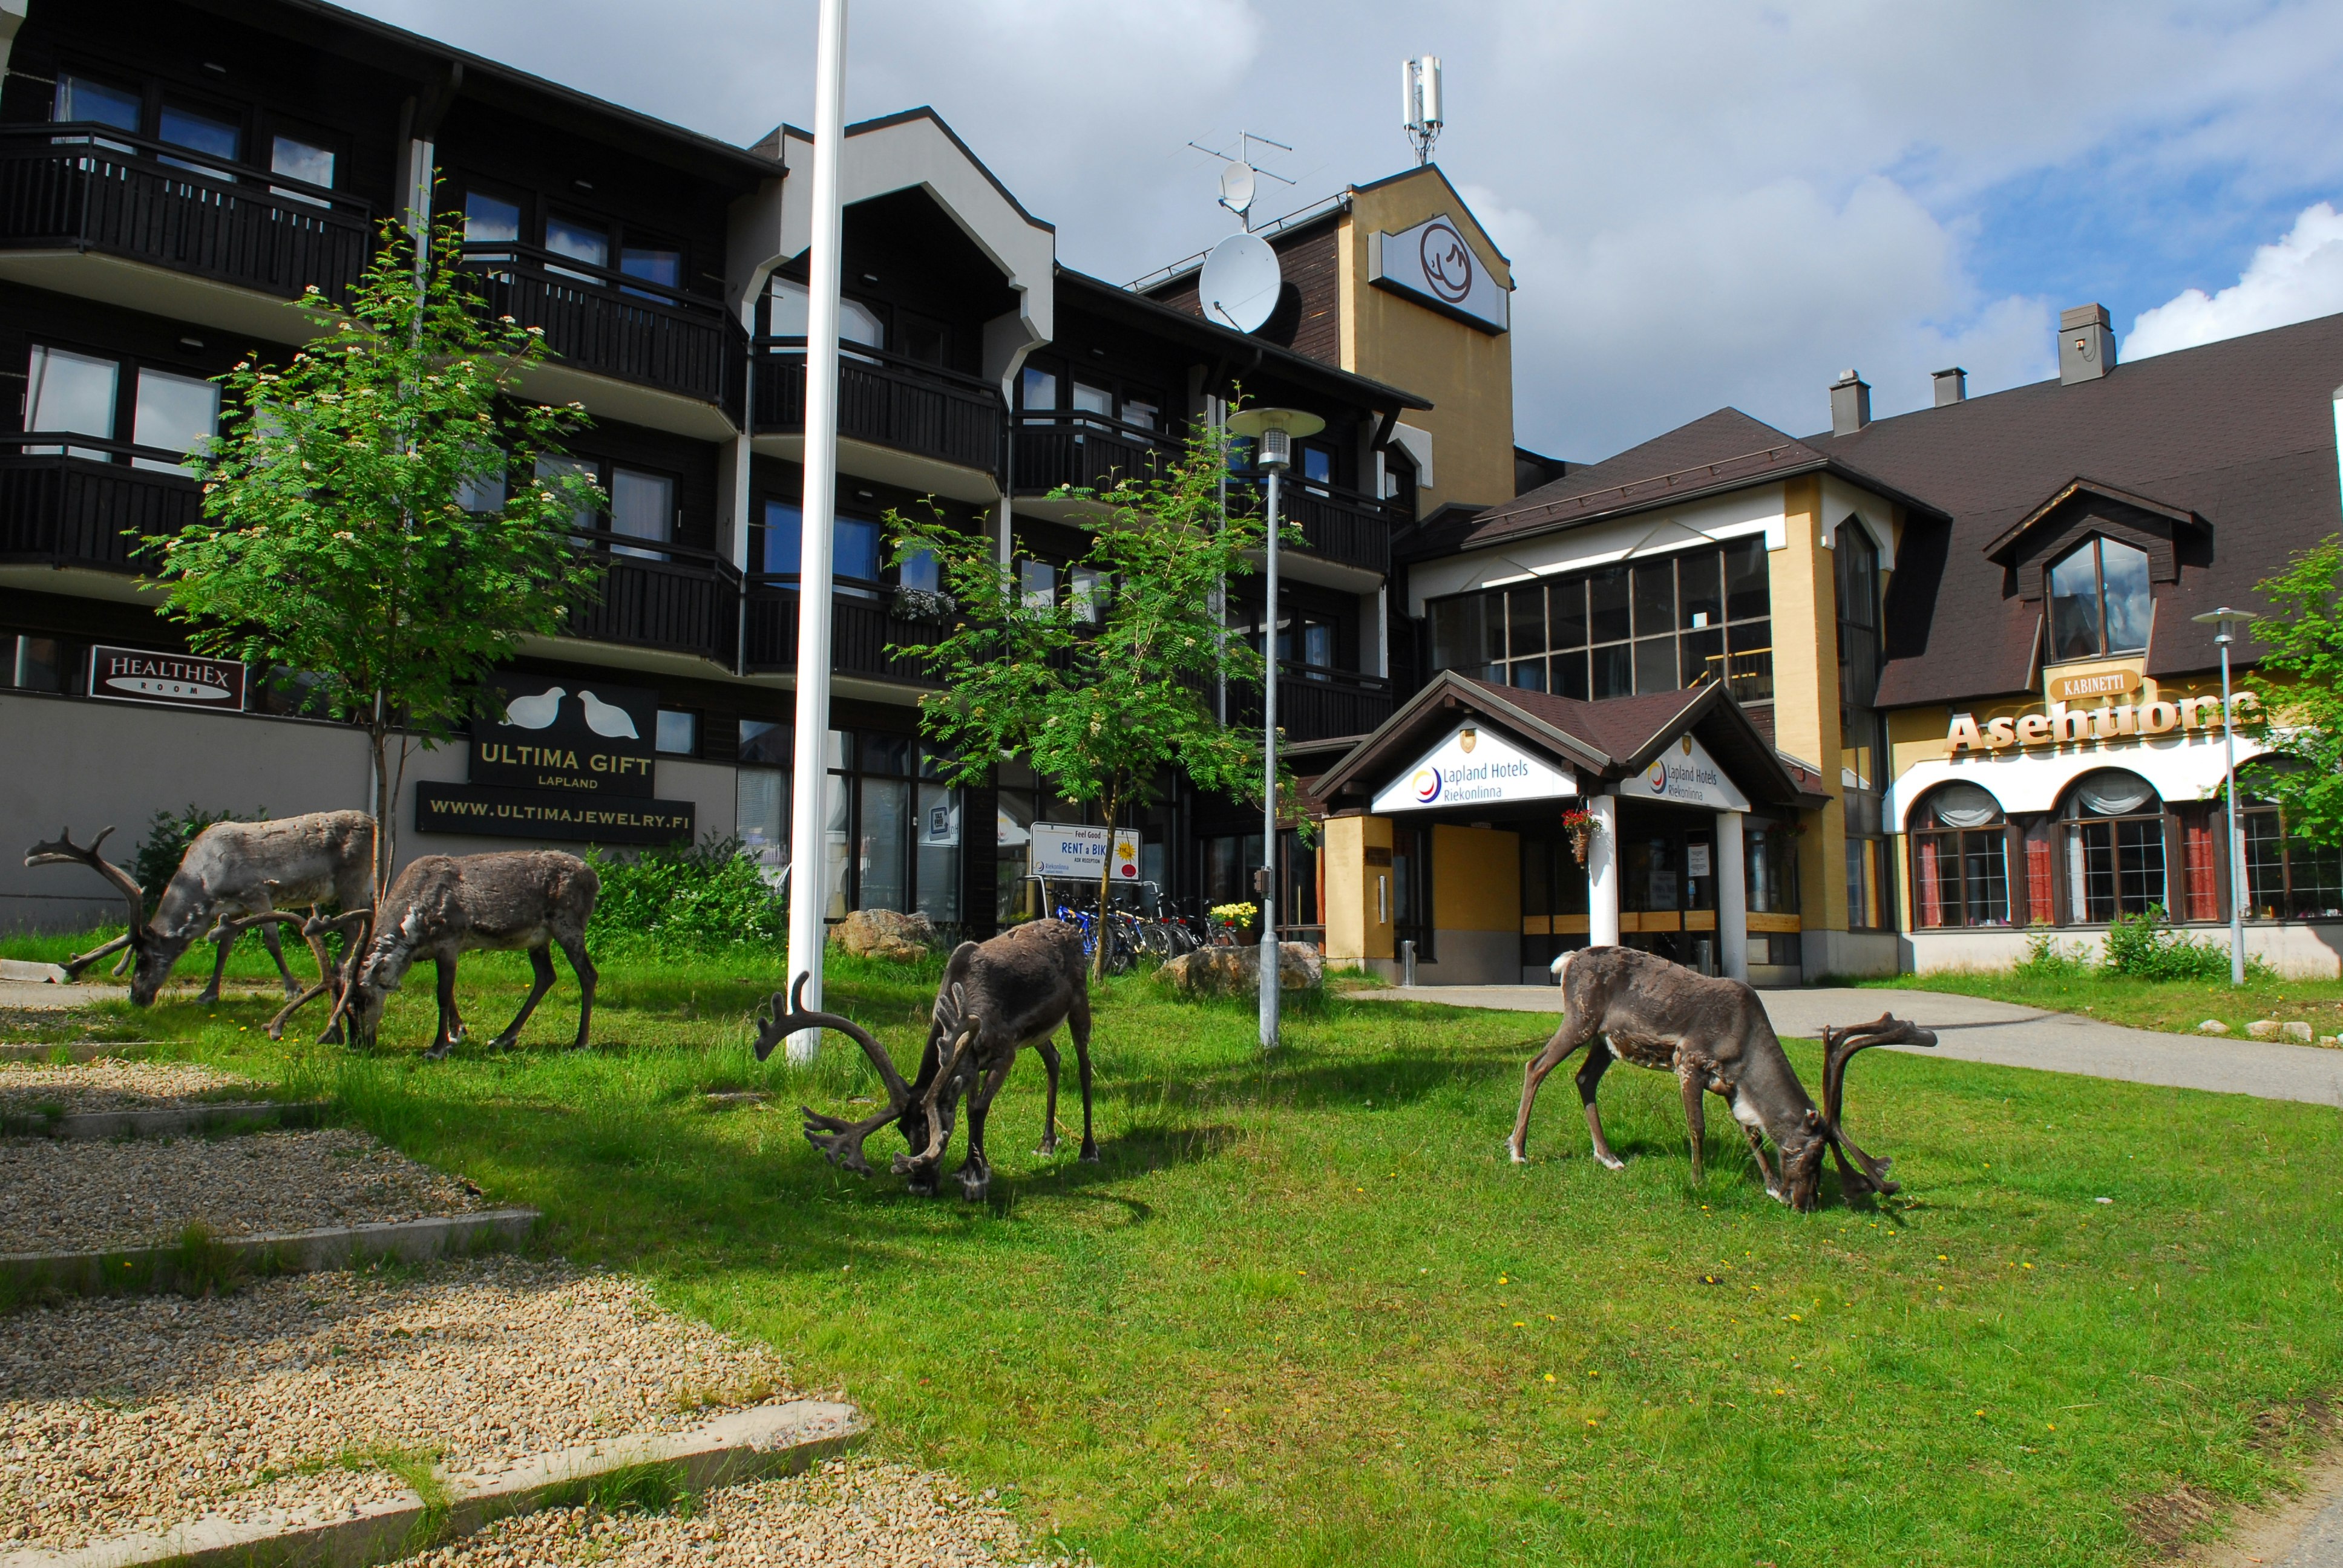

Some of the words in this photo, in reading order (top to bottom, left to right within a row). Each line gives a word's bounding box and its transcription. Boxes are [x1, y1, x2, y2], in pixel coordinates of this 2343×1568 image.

[140, 682, 198, 694] ROOM
[2063, 673, 2125, 696] KABINETTI
[481, 743, 580, 769] ULTIMA
[589, 754, 652, 776] GIFT
[1444, 762, 1487, 785] Lapland
[1492, 759, 1528, 779] Hotels
[1667, 764, 1694, 783] Lapland
[1696, 769, 1717, 785] Hotels
[538, 775, 598, 789] LAPLAND
[1444, 785, 1502, 802] Riekonlinna
[1668, 785, 1703, 801] Riekonlinna
[430, 799, 689, 829] WWW.ULTIMAJEWELRY.FI
[1062, 842, 1083, 854] RENT
[1092, 844, 1107, 856] BIK
